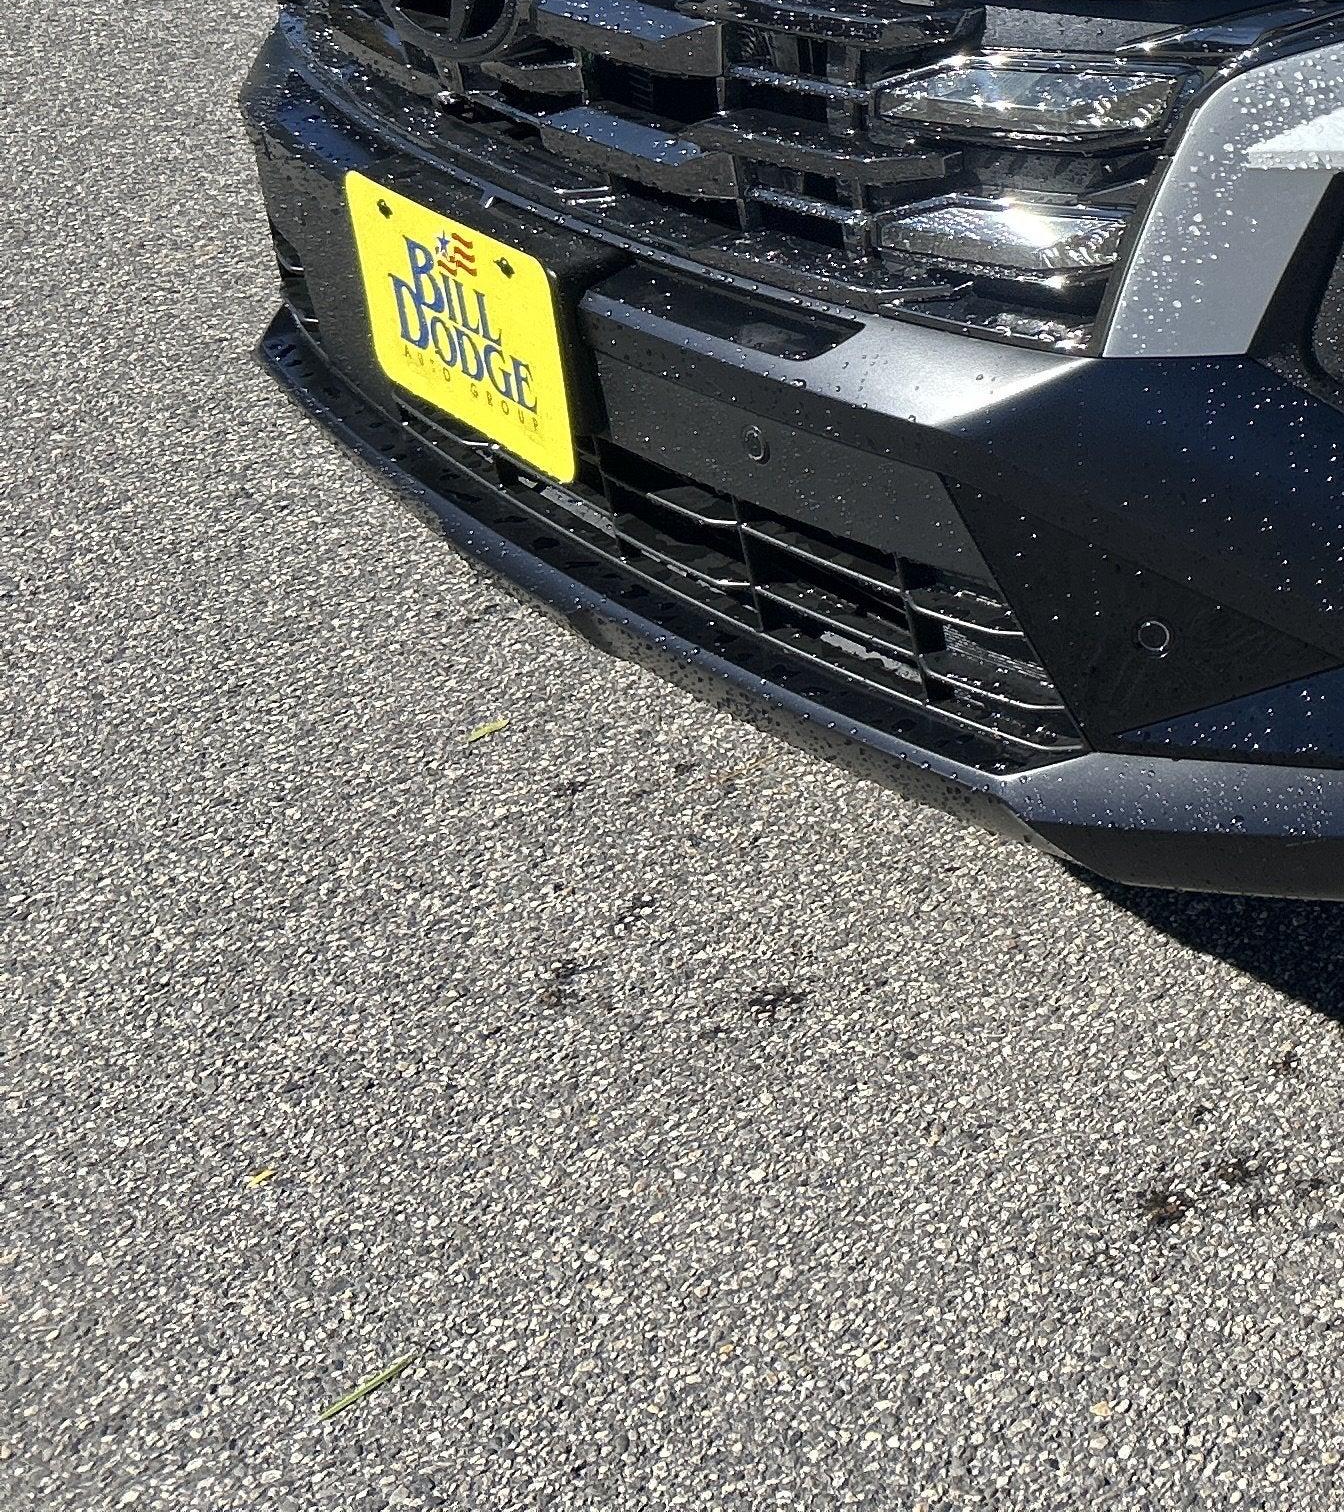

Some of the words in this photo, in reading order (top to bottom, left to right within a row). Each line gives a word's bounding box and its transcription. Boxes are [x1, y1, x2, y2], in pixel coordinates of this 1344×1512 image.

[388, 272, 538, 415] DODGE
[402, 234, 503, 348] BILL
[402, 344, 453, 383] AUTO
[469, 382, 540, 432] GROUP
